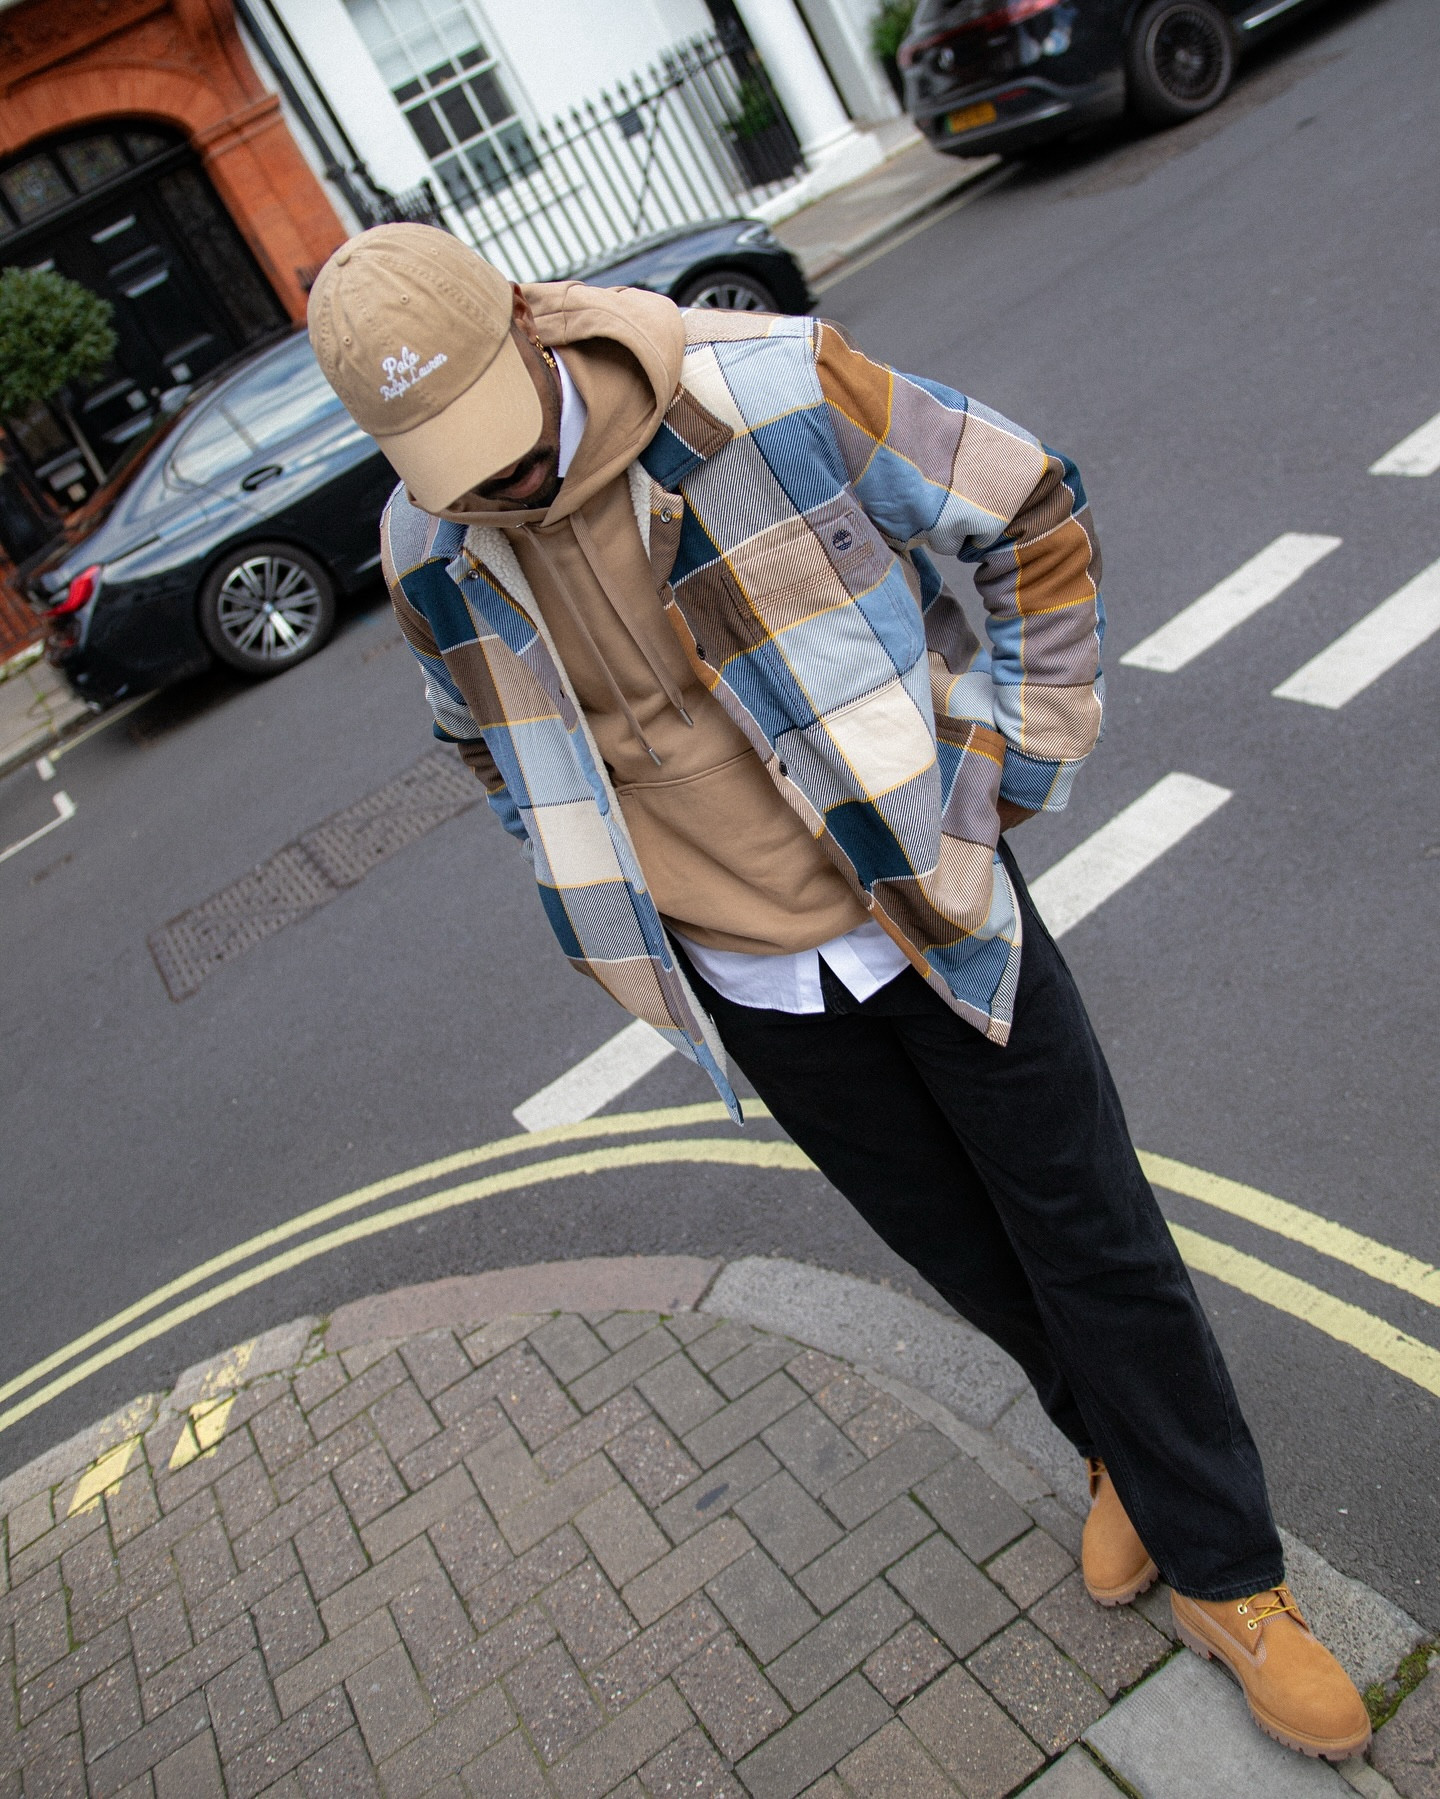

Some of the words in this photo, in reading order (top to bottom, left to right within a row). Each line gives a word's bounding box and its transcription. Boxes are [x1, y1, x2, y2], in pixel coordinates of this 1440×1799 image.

[380, 375, 411, 402] Ralph
[409, 353, 448, 384] Lauren
[382, 346, 420, 381] Polo
